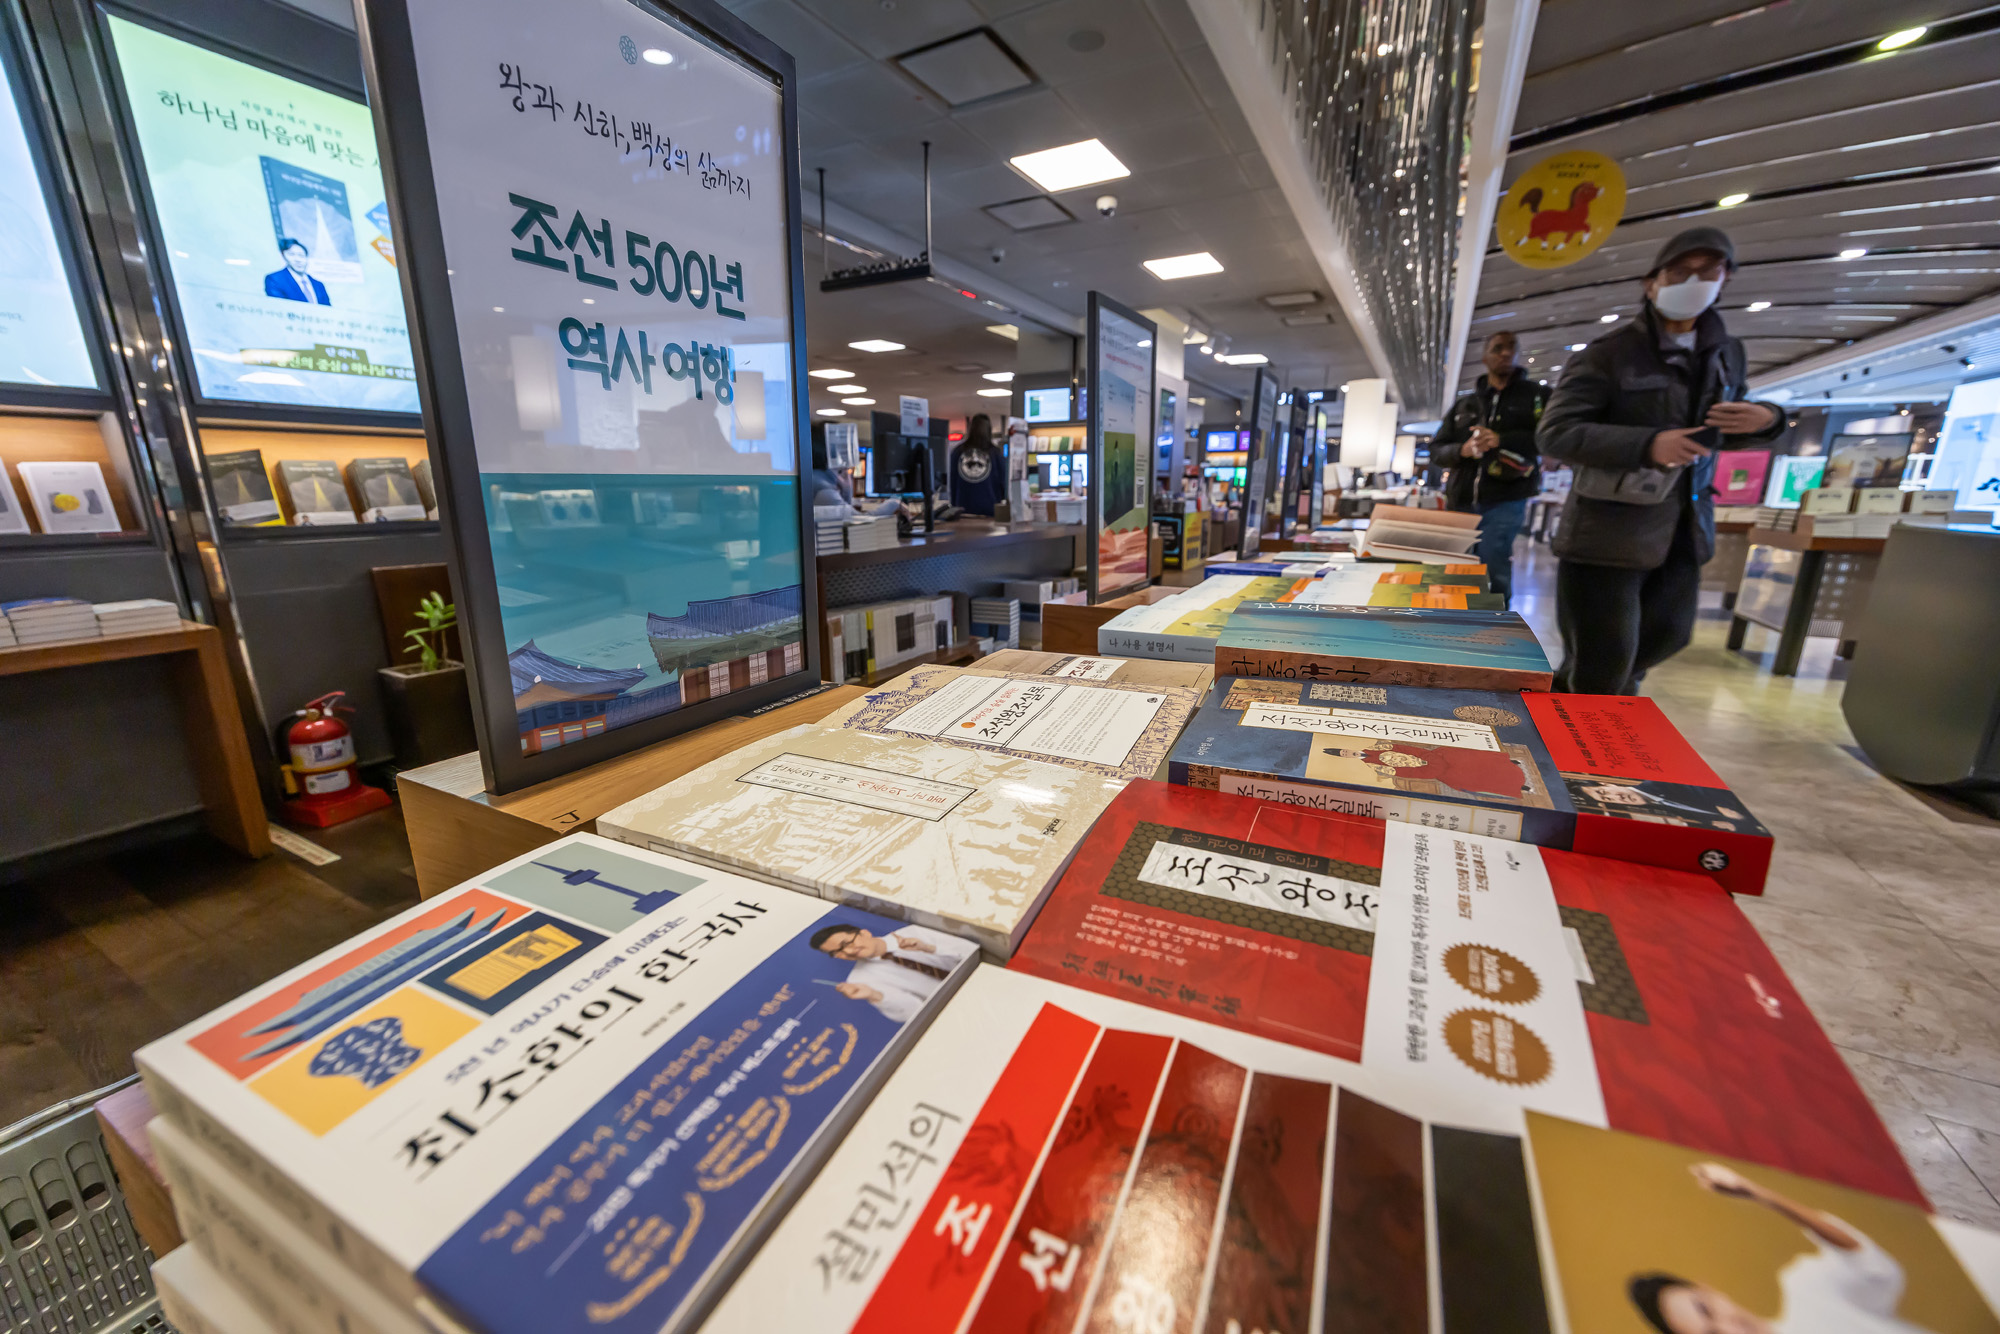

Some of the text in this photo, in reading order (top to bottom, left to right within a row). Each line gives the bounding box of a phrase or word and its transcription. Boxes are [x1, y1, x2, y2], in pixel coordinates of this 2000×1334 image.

[157, 89, 364, 168] 하나님 마음에 맞는
[500, 62, 565, 122] 왕과
[697, 151, 752, 200] 삶까지
[508, 191, 747, 321] 조선 500년
[558, 316, 737, 406] 역사 여행
[1109, 637, 1176, 654] 나 사용 설명서
[978, 685, 1052, 739] 조선왕조실록
[1260, 713, 1470, 742] 조선왕조실록
[1237, 784, 1383, 818] 조선왕조실록
[1181, 832, 1319, 869] 한 권으로 읽는
[570, 954, 627, 995] 단숨에
[624, 914, 689, 956] 이해되는
[394, 983, 645, 1184] 최소한의
[634, 898, 770, 985] 한국사
[814, 1101, 963, 1294] 설민석의
